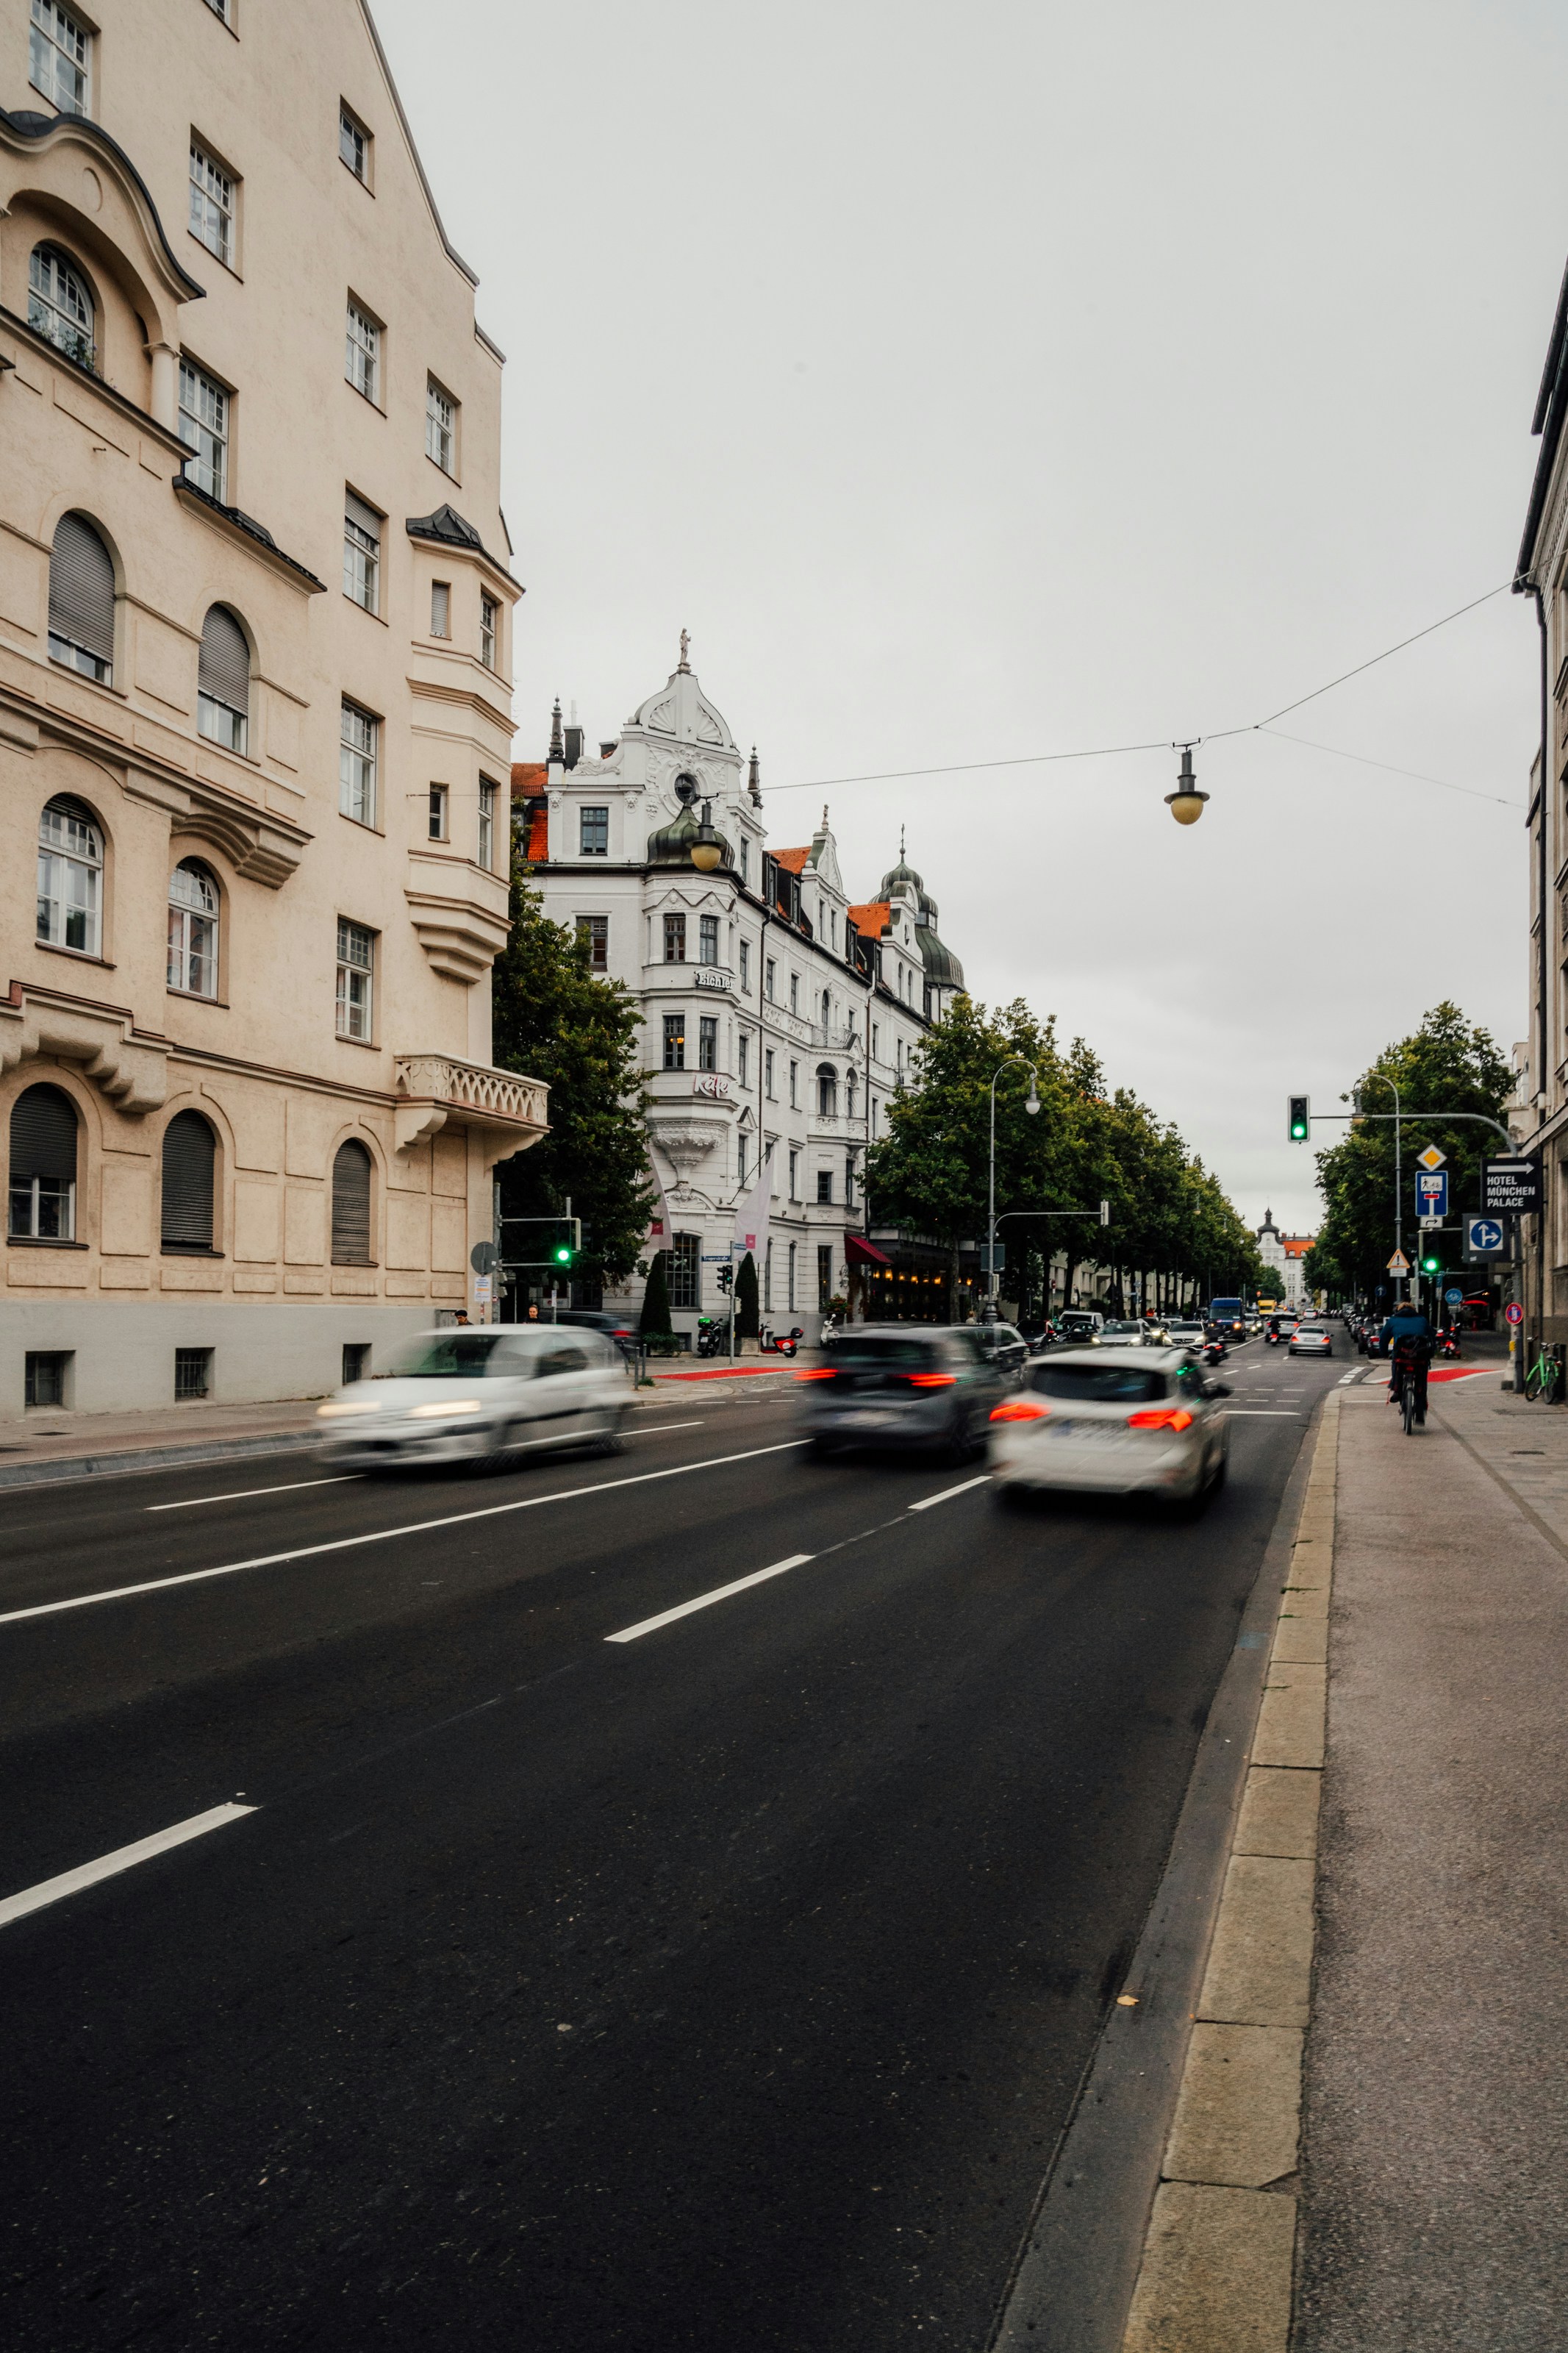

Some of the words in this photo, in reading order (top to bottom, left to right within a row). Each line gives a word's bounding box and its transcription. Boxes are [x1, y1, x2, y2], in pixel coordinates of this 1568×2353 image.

[698, 973, 735, 989] Eichler
[694, 1074, 730, 1098] Käfe
[1486, 1176, 1518, 1185] HOTEL
[1486, 1185, 1536, 1196] MÜNCHEN
[1486, 1197, 1525, 1207] PALACE
